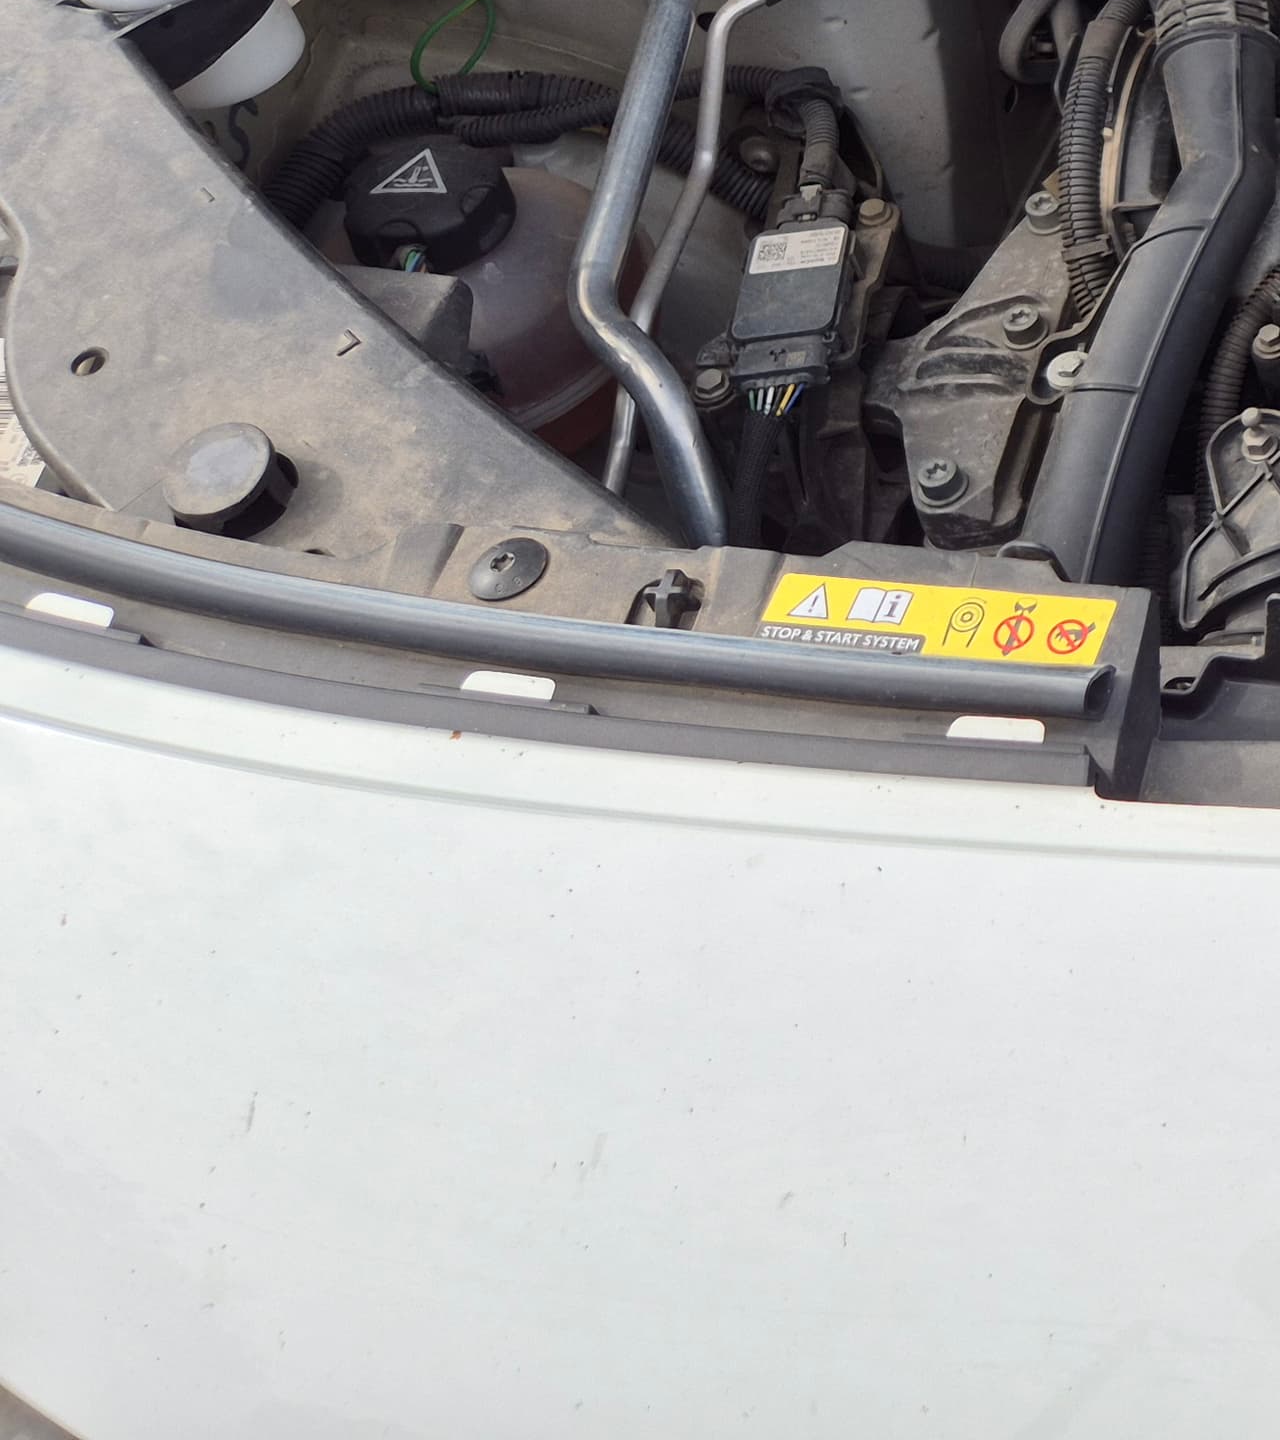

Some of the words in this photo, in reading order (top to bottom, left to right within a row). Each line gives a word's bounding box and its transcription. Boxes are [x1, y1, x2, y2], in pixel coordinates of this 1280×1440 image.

[761, 626, 801, 641] STOP
[800, 630, 813, 642] &
[814, 630, 863, 646] START
[863, 634, 920, 651] SYSTEM
